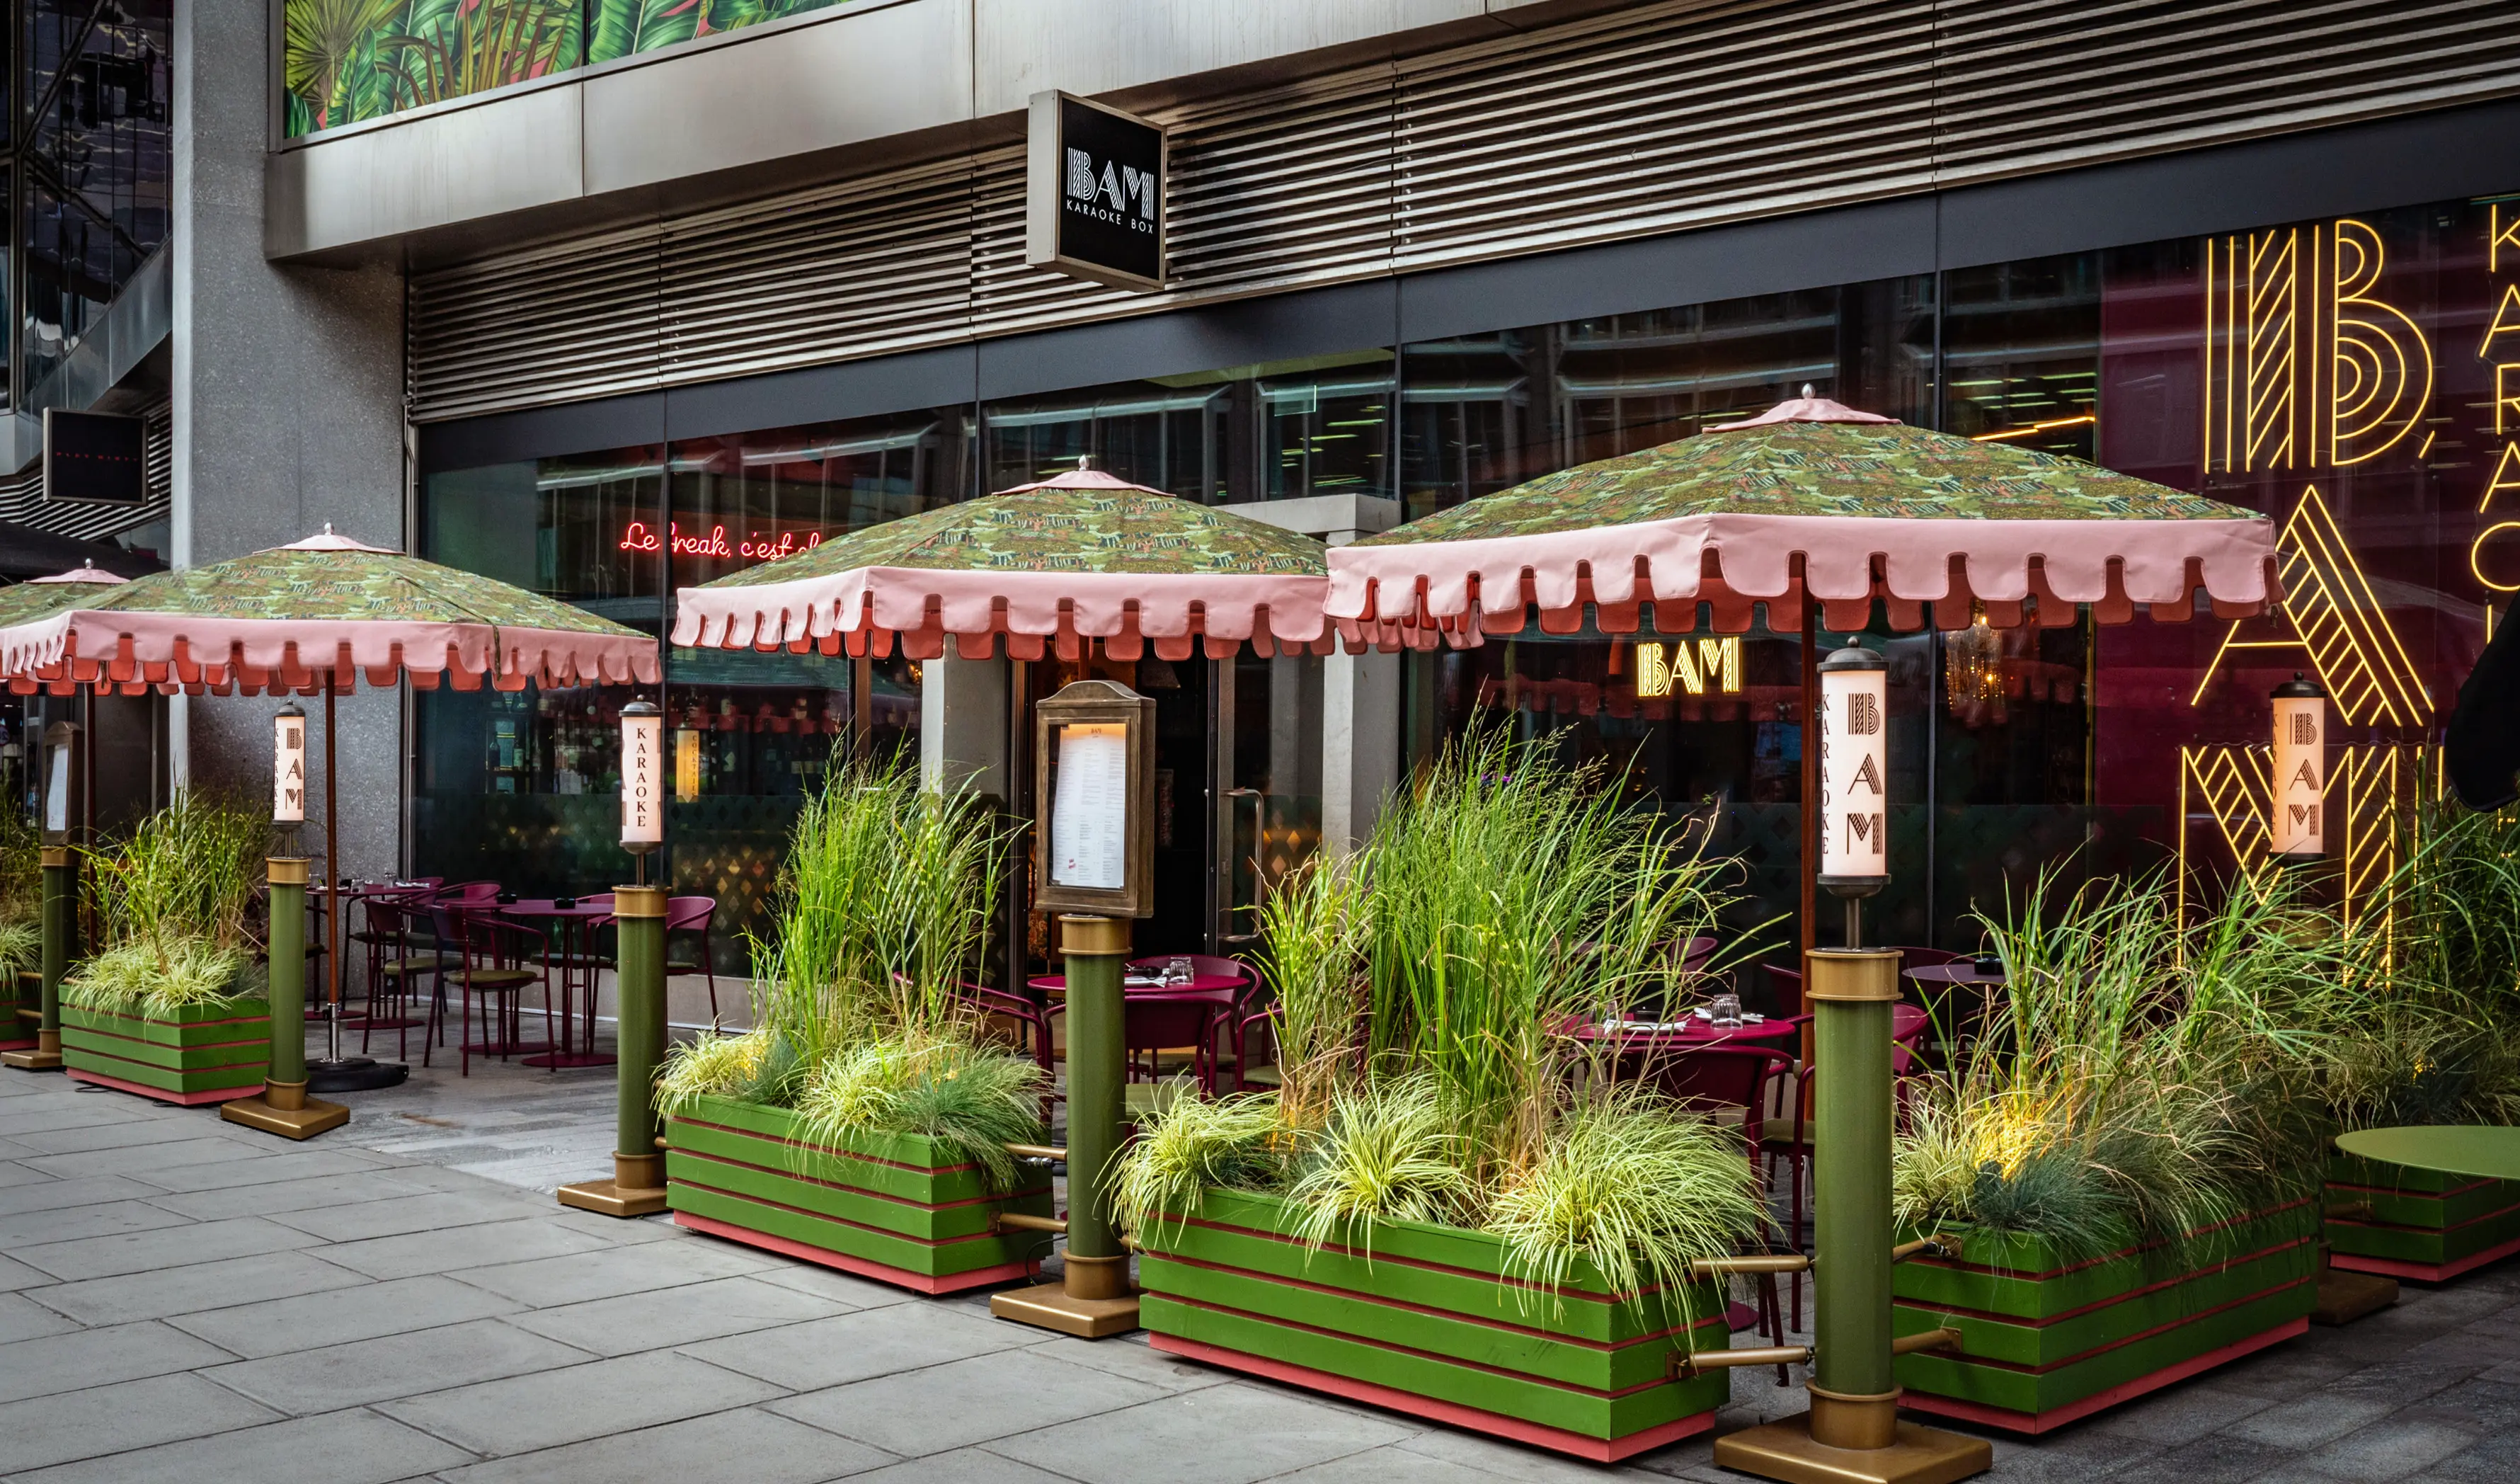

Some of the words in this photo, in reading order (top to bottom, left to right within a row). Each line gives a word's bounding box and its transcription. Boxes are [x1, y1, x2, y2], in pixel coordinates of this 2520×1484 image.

[1067, 147, 1155, 220] BAM
[1067, 199, 1121, 224] KARAOKE
[1131, 218, 1154, 234] BOX
[2472, 202, 2520, 645] KARAO
[620, 522, 660, 550] Le
[1638, 637, 1740, 697] BAM
[285, 727, 303, 810] BAM
[636, 727, 647, 827] KARAOKE
[1847, 692, 1883, 855] BAM
[2288, 713, 2320, 836] BAM
